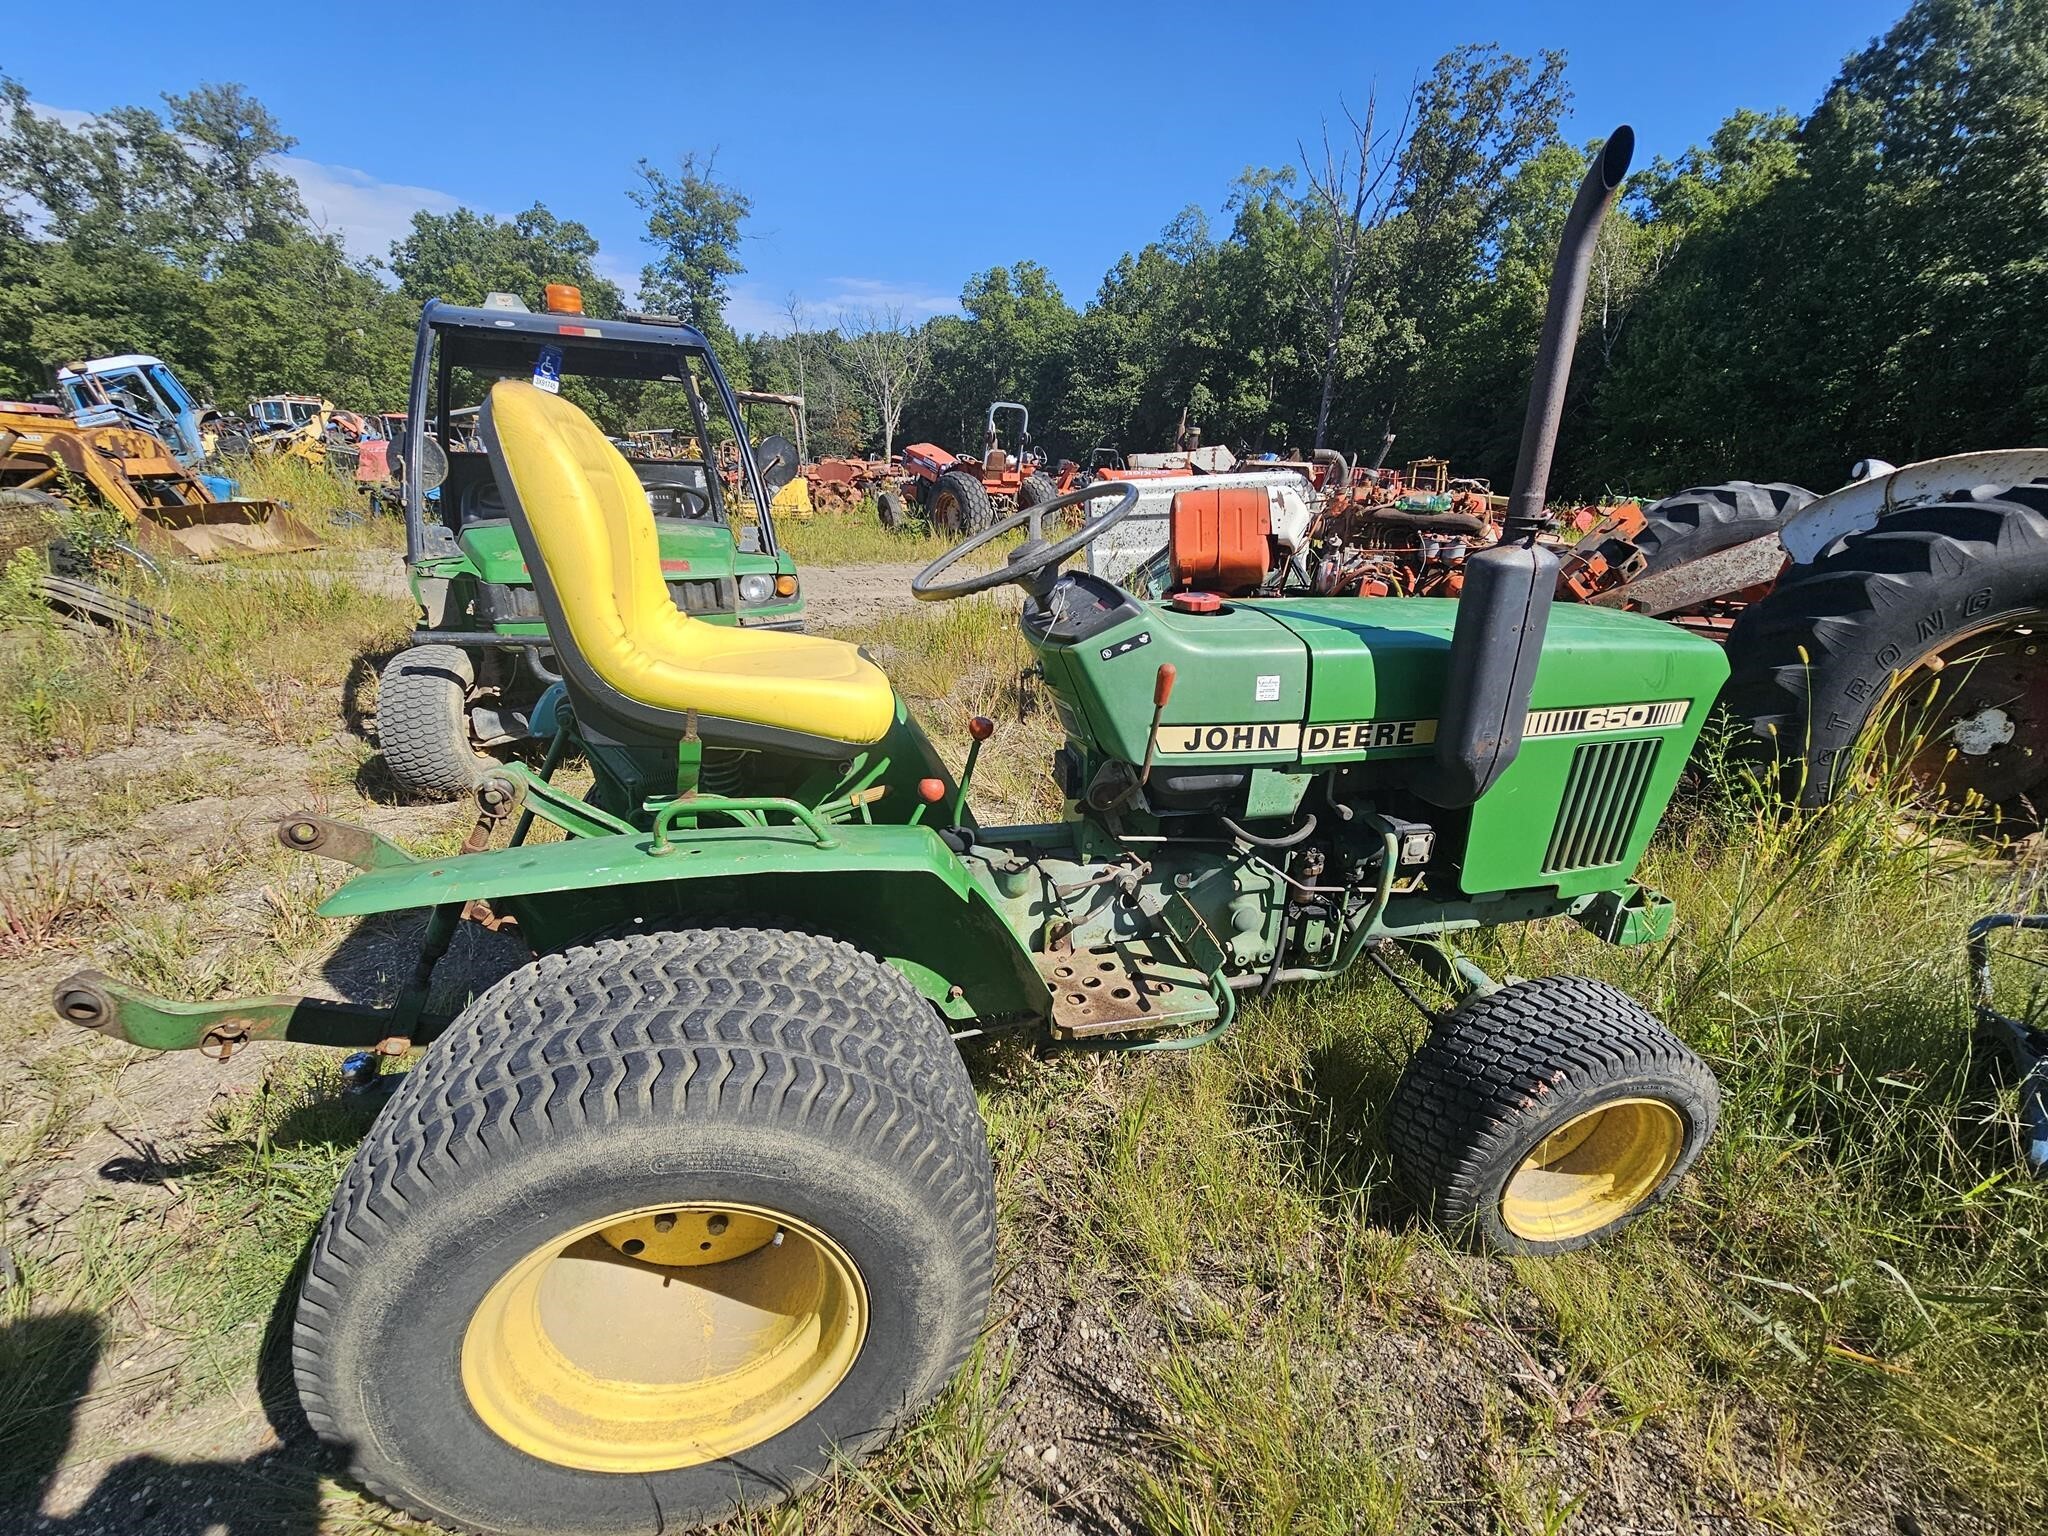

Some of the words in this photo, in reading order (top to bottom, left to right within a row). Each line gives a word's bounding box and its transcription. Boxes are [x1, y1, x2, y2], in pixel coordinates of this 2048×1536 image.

[1583, 705, 1651, 731] 650
[1184, 725, 1281, 751] JOHN
[1308, 722, 1417, 751] DEERE
